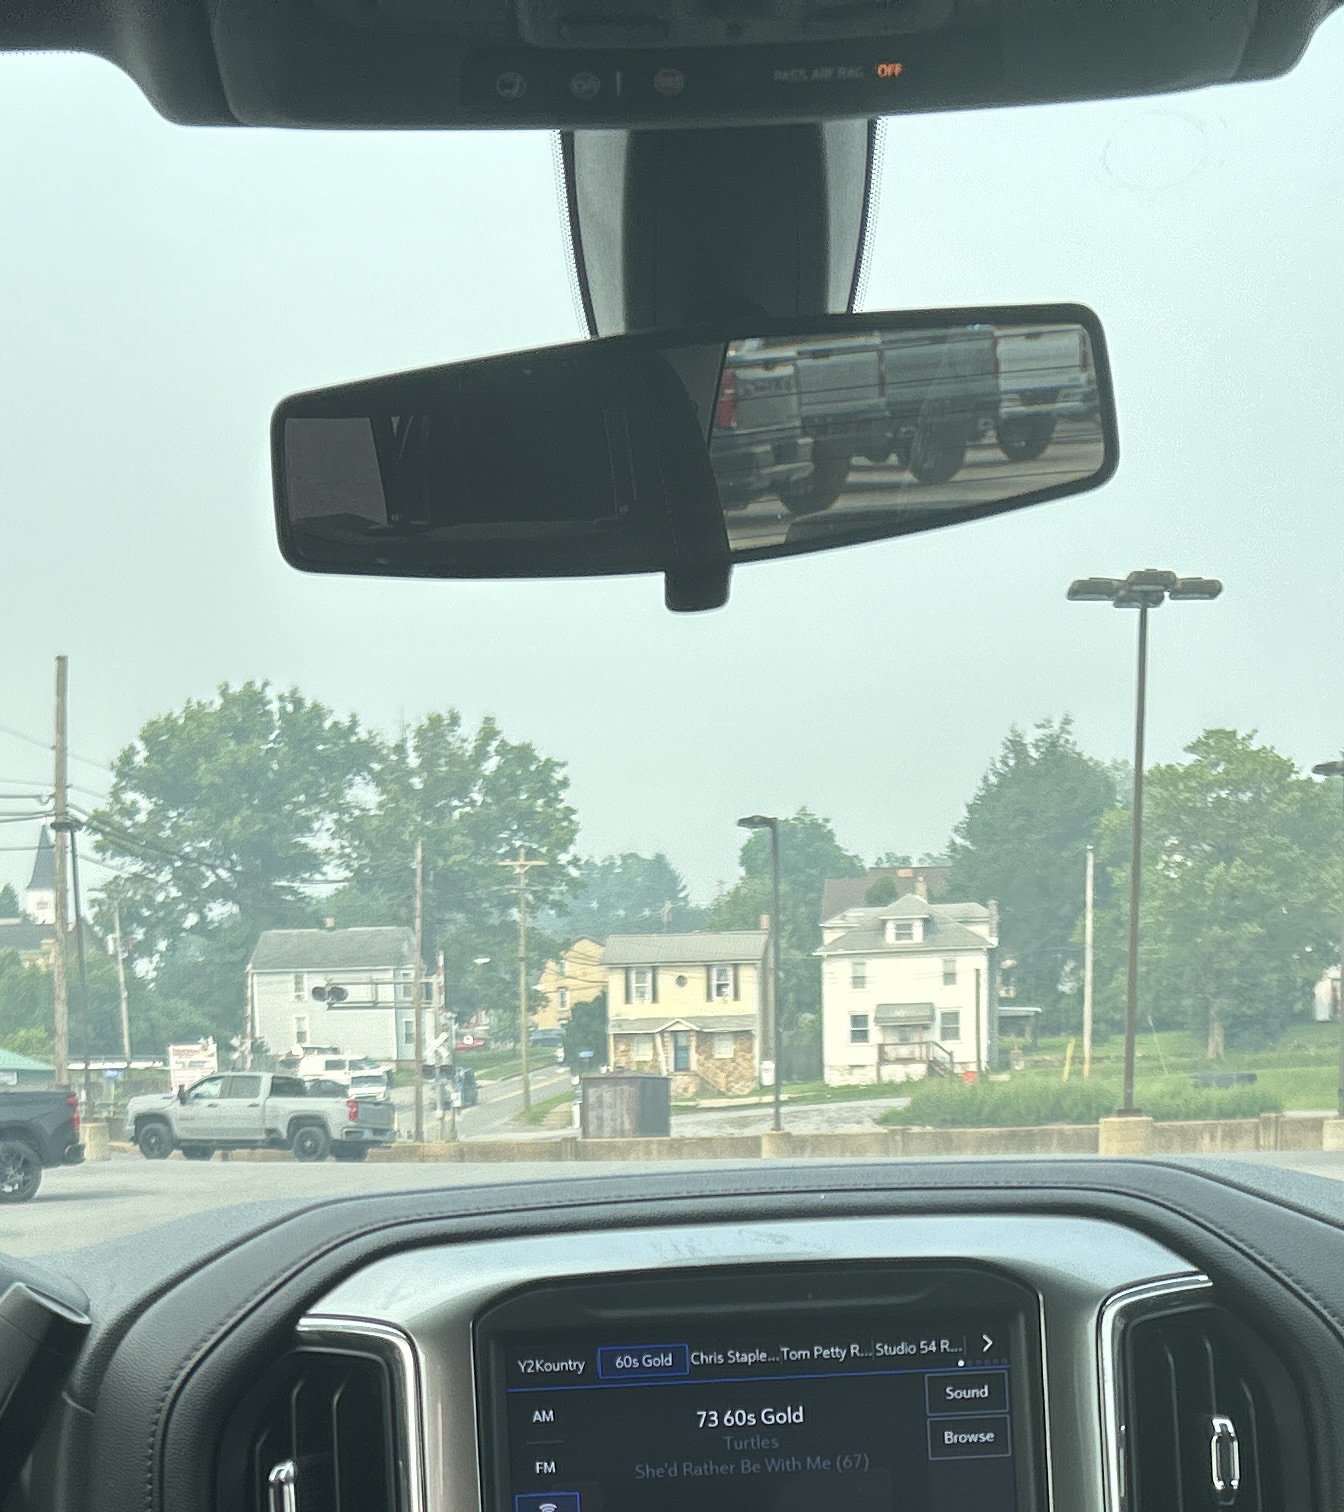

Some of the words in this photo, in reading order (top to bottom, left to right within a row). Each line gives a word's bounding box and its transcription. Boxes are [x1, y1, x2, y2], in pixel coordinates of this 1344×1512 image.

[877, 63, 903, 78] OFF
[780, 1347, 810, 1361] Tom
[814, 1345, 848, 1362] Petty
[875, 1342, 917, 1357] Studio
[920, 1340, 937, 1353] 54
[615, 1355, 640, 1369] 60s
[642, 1353, 673, 1367] Gold
[690, 1350, 725, 1365] Chris
[518, 1359, 586, 1374] Y2Kountry
[945, 1385, 989, 1400] Sound
[532, 1409, 555, 1423] AM
[696, 1411, 720, 1428] 73
[723, 1409, 757, 1426] 60s
[761, 1406, 804, 1425] Gold
[723, 1434, 780, 1451] Turtles
[944, 1430, 995, 1445] Browse
[535, 1461, 556, 1474] FM
[635, 1462, 678, 1479] She'd
[683, 1459, 736, 1477] Rather
[741, 1459, 762, 1474] Be
[766, 1457, 802, 1473] With
[806, 1455, 832, 1471] Me
[836, 1453, 870, 1473] (67)
